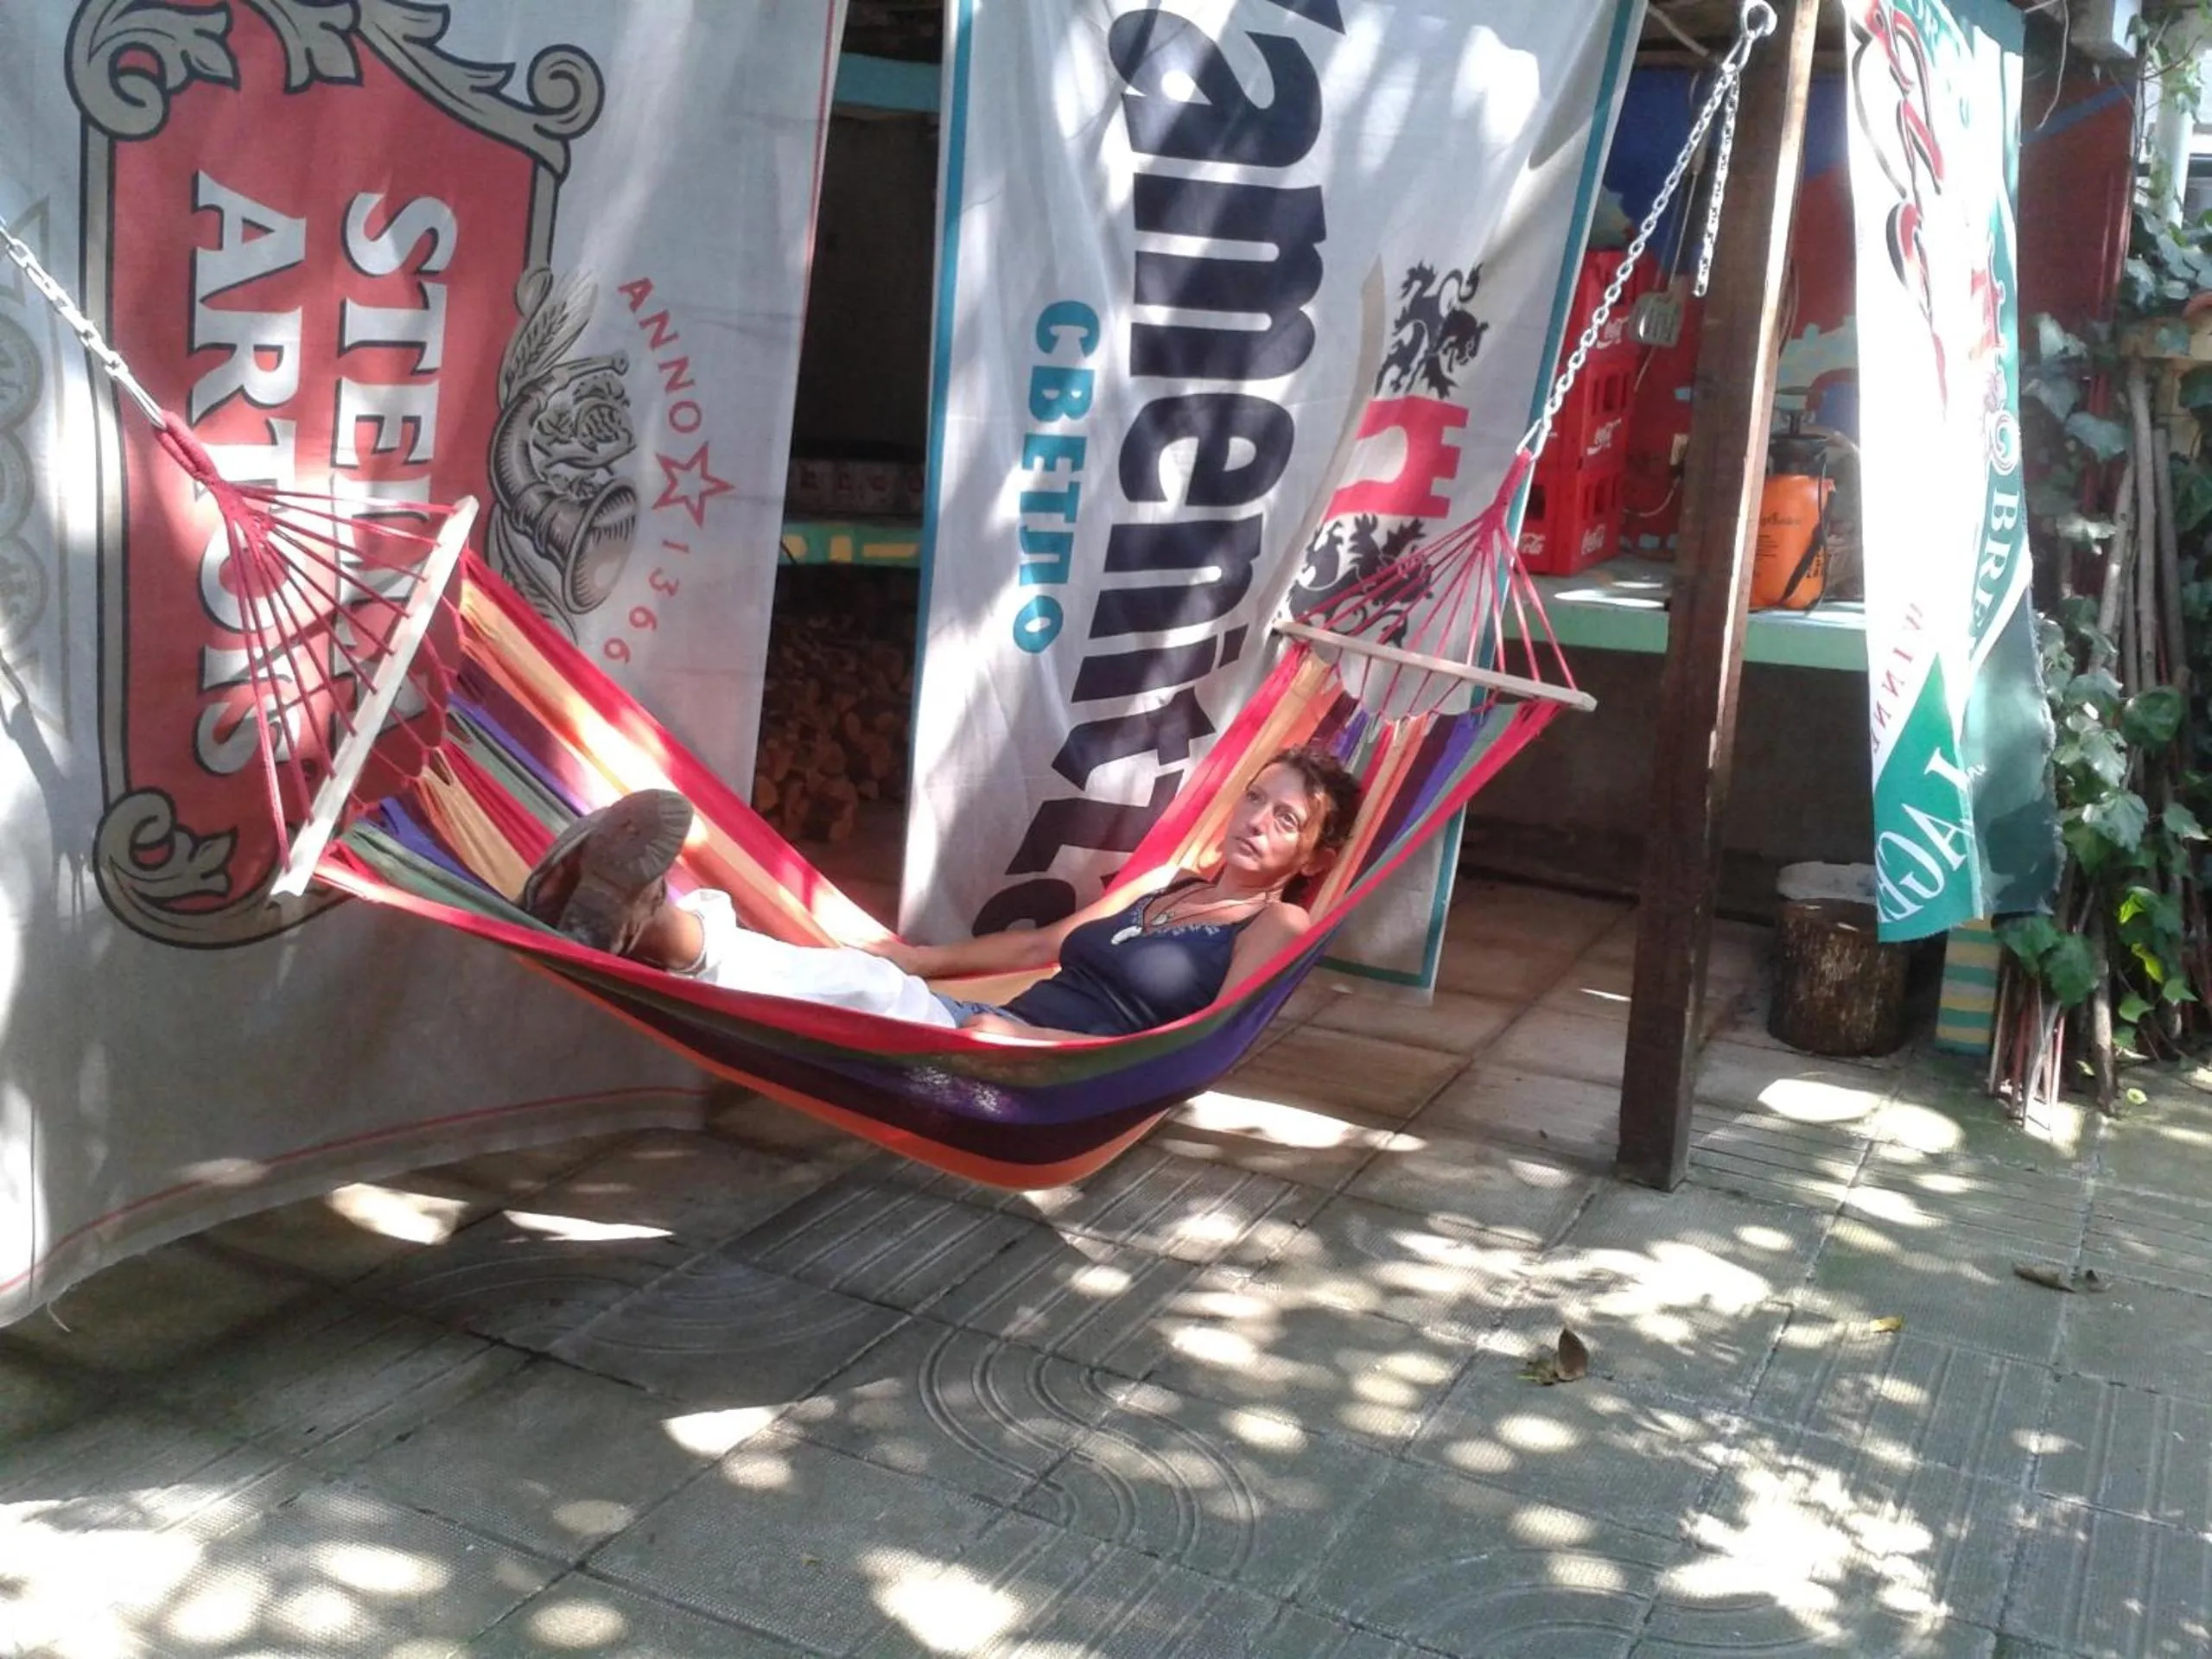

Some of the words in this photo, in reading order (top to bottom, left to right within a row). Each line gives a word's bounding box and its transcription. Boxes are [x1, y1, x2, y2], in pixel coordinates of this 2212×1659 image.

[188, 168, 307, 776] ARTOIS
[330, 192, 460, 758] STELLA
[618, 276, 702, 434] ANNO
[971, 0, 1345, 937] amenitz
[1013, 300, 1101, 654] СВЕТЛО
[603, 538, 690, 664] 1366
